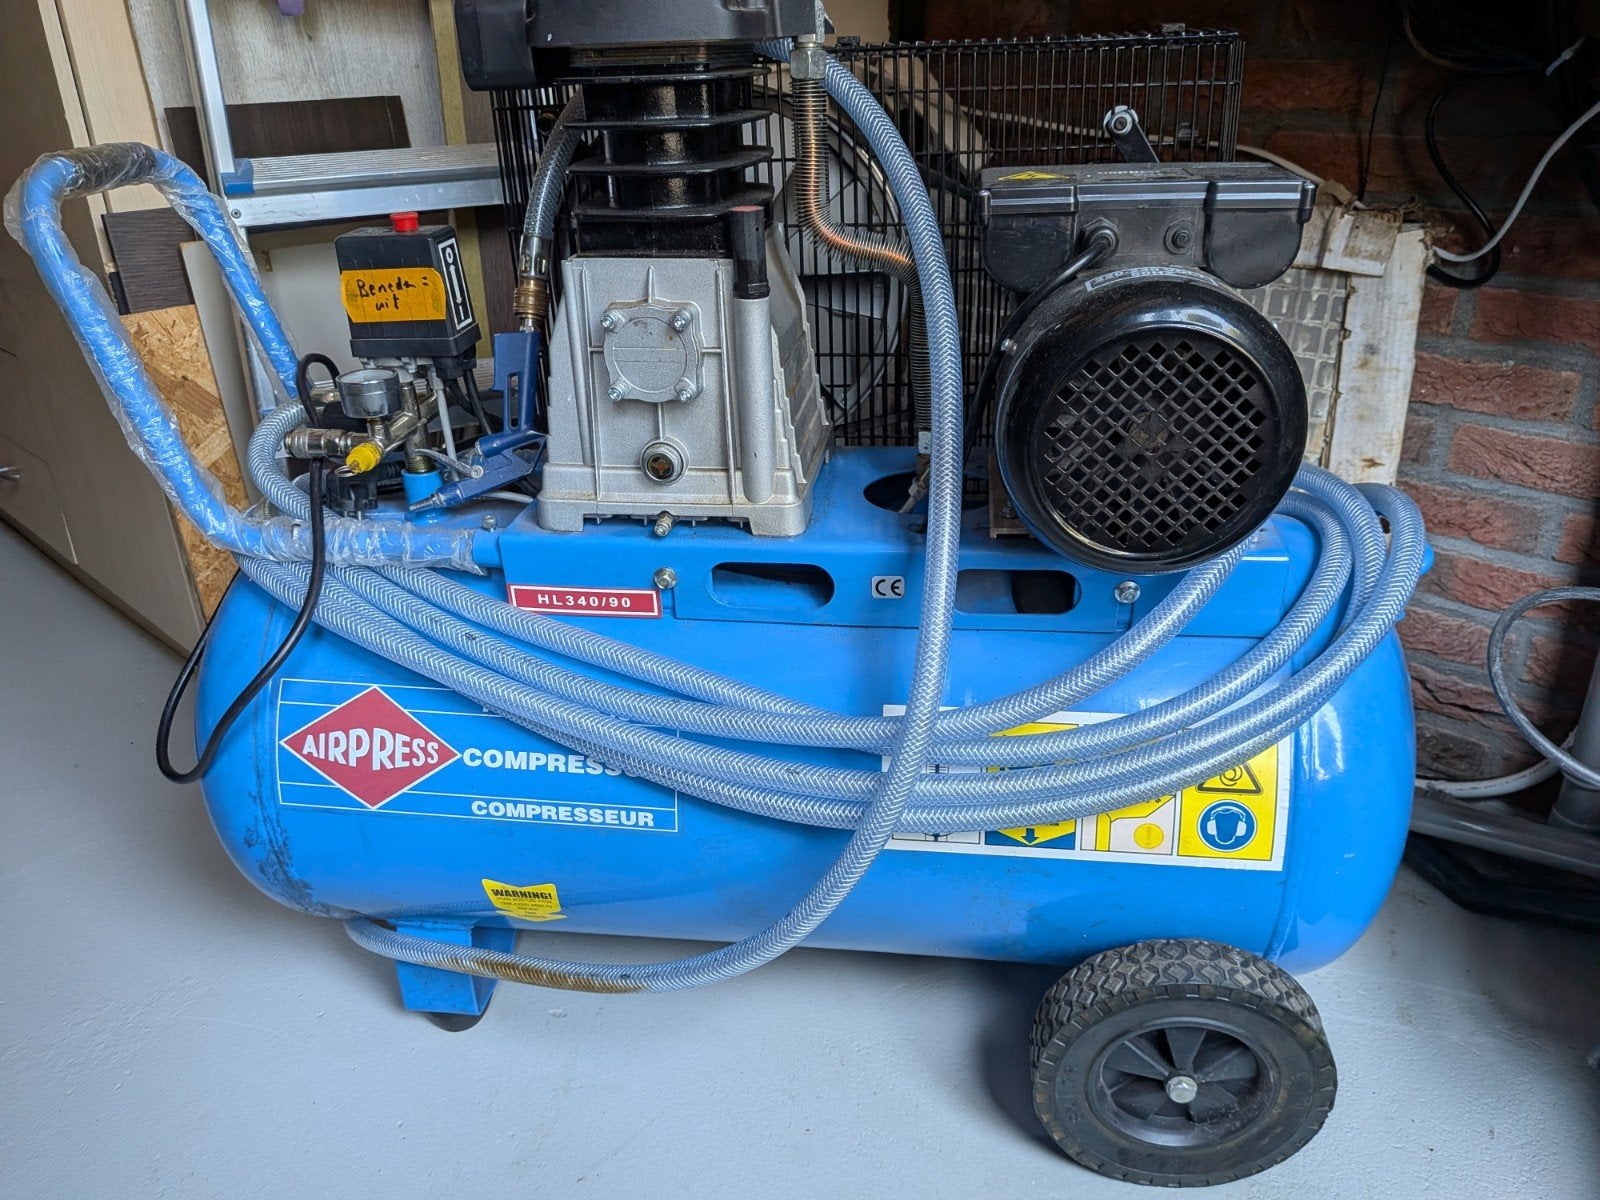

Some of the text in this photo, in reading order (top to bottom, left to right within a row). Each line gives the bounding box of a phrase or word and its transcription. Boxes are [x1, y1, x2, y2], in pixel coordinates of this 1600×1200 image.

[537, 593, 631, 608] HL340/90
[302, 727, 439, 771] AIRPRESS
[463, 747, 638, 778] COMPRESS
[471, 800, 654, 827] COMPRESSEUR
[491, 888, 553, 900] WARNING!
